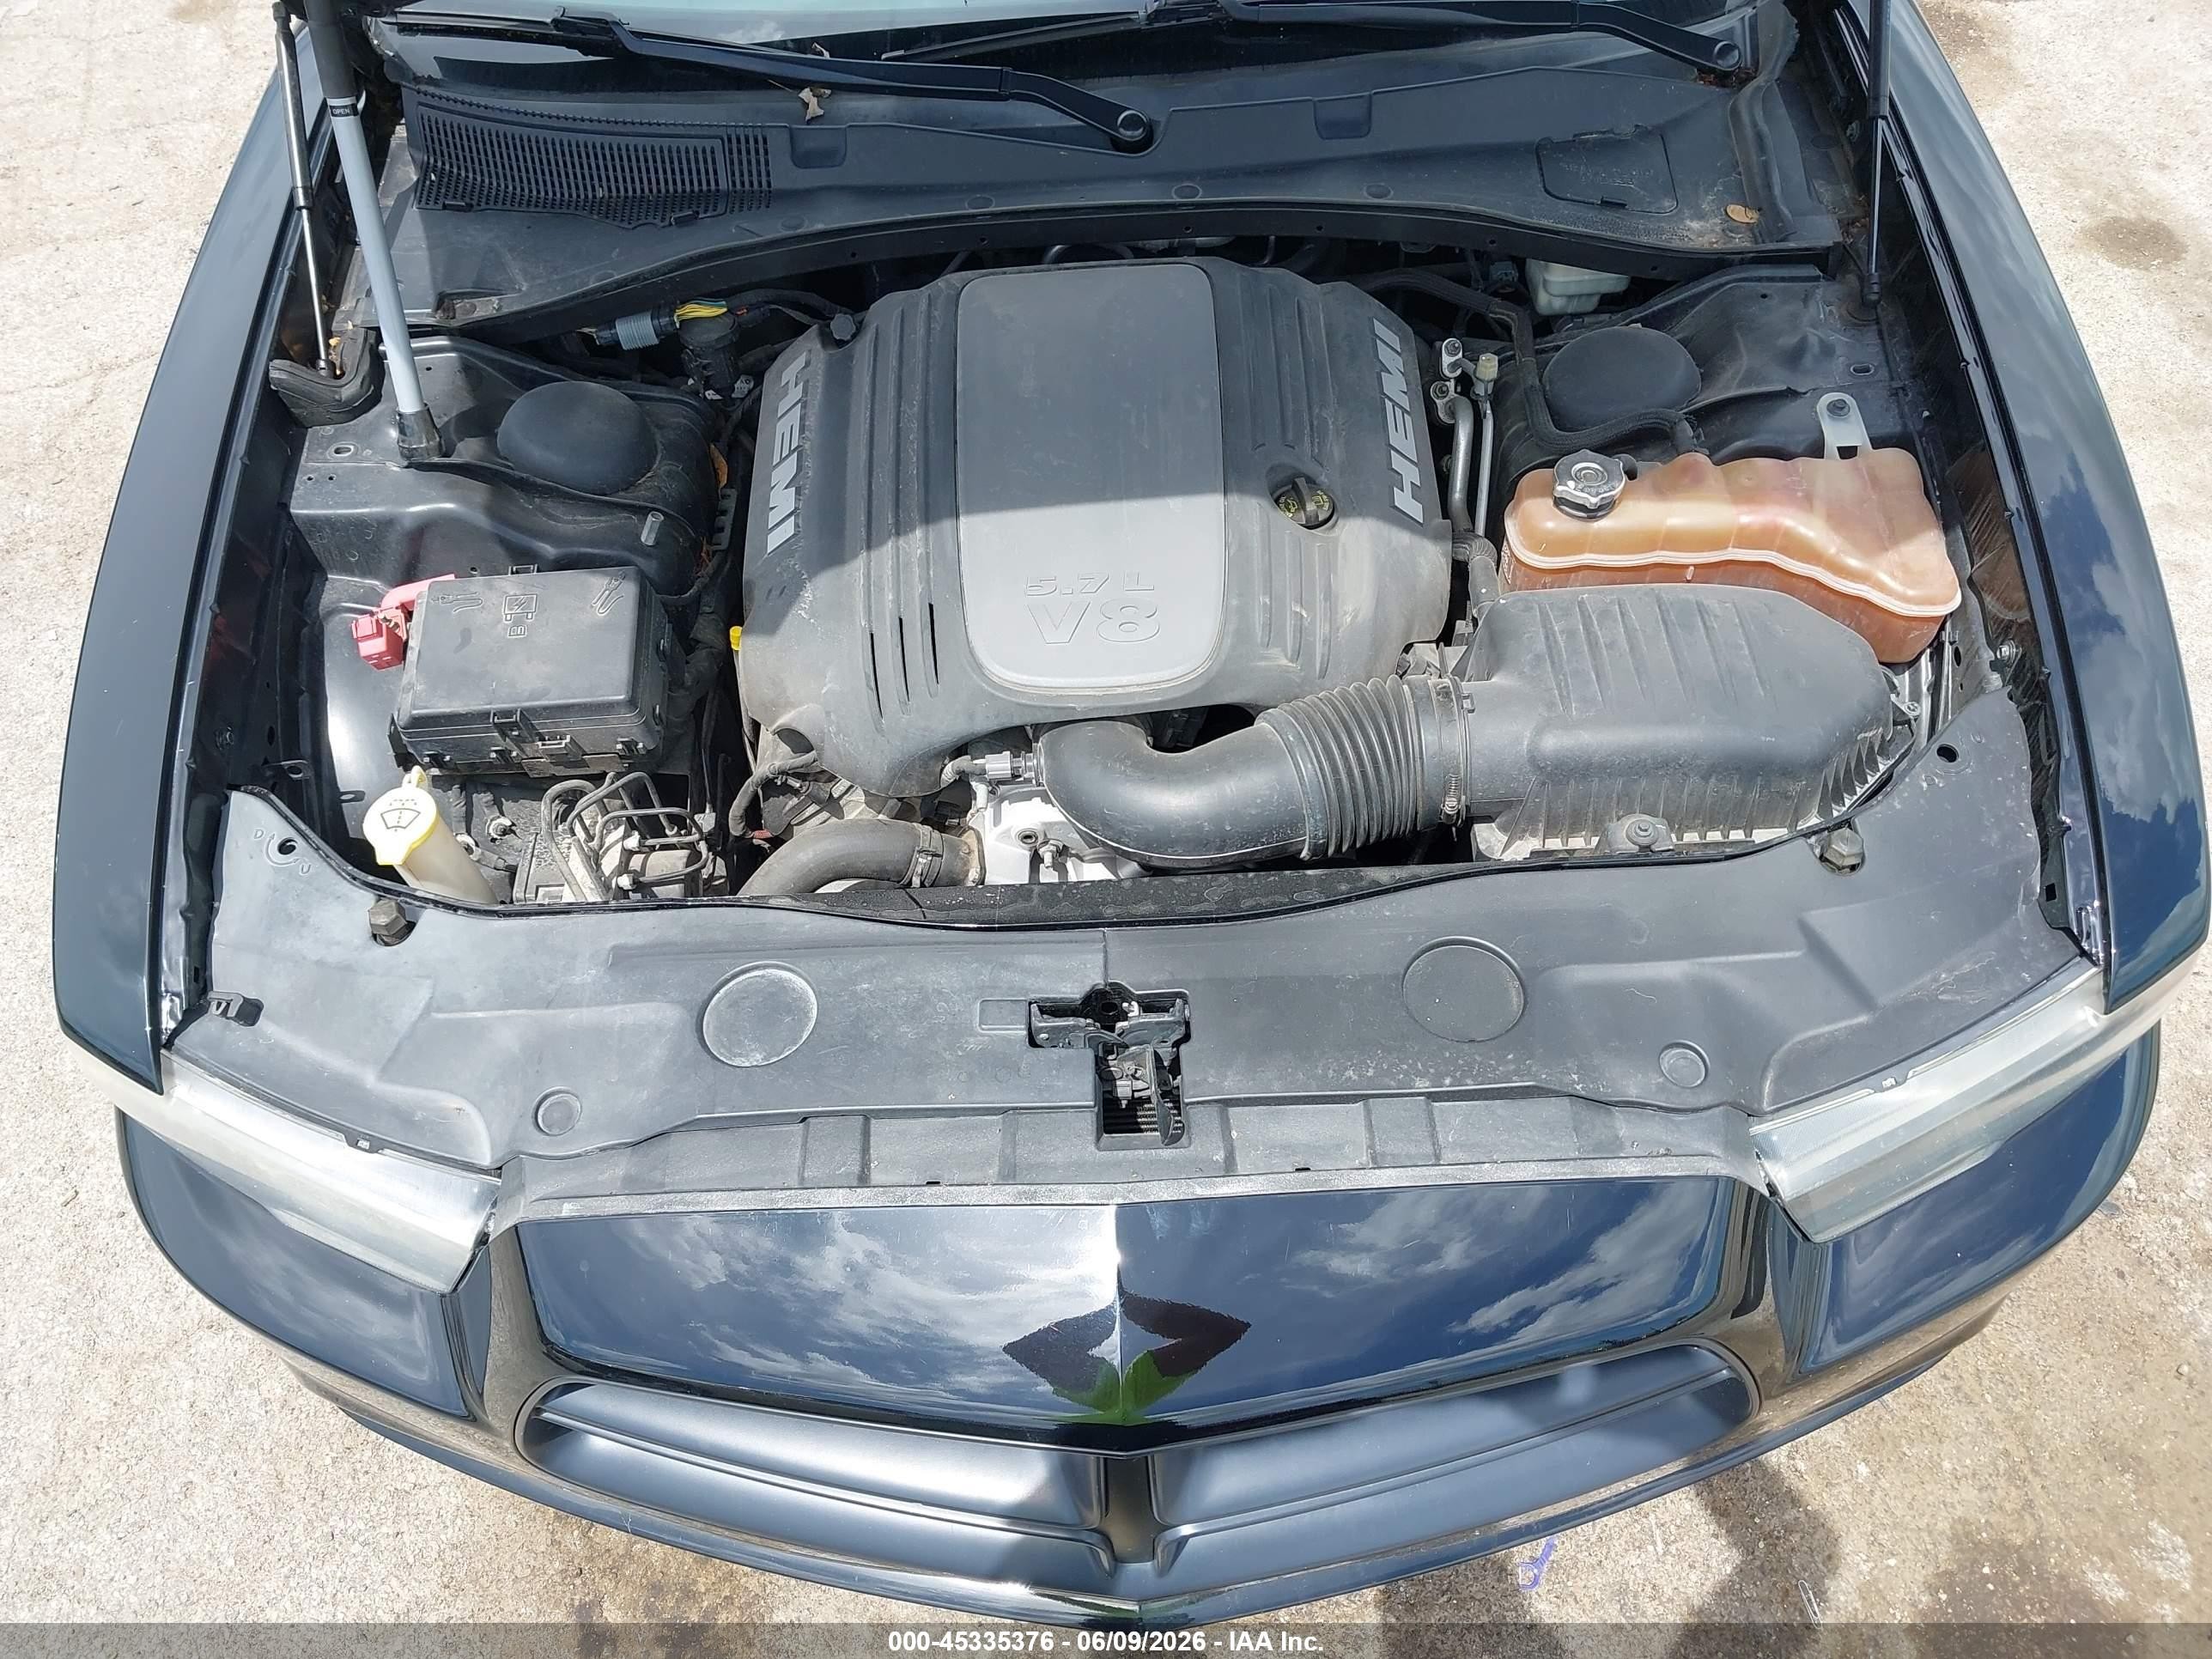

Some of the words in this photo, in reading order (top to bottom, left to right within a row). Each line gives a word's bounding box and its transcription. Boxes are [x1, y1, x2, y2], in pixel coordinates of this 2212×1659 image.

[767, 350, 806, 556] HEMI
[1372, 317, 1424, 524] HEMI
[1024, 598, 1160, 645] V8
